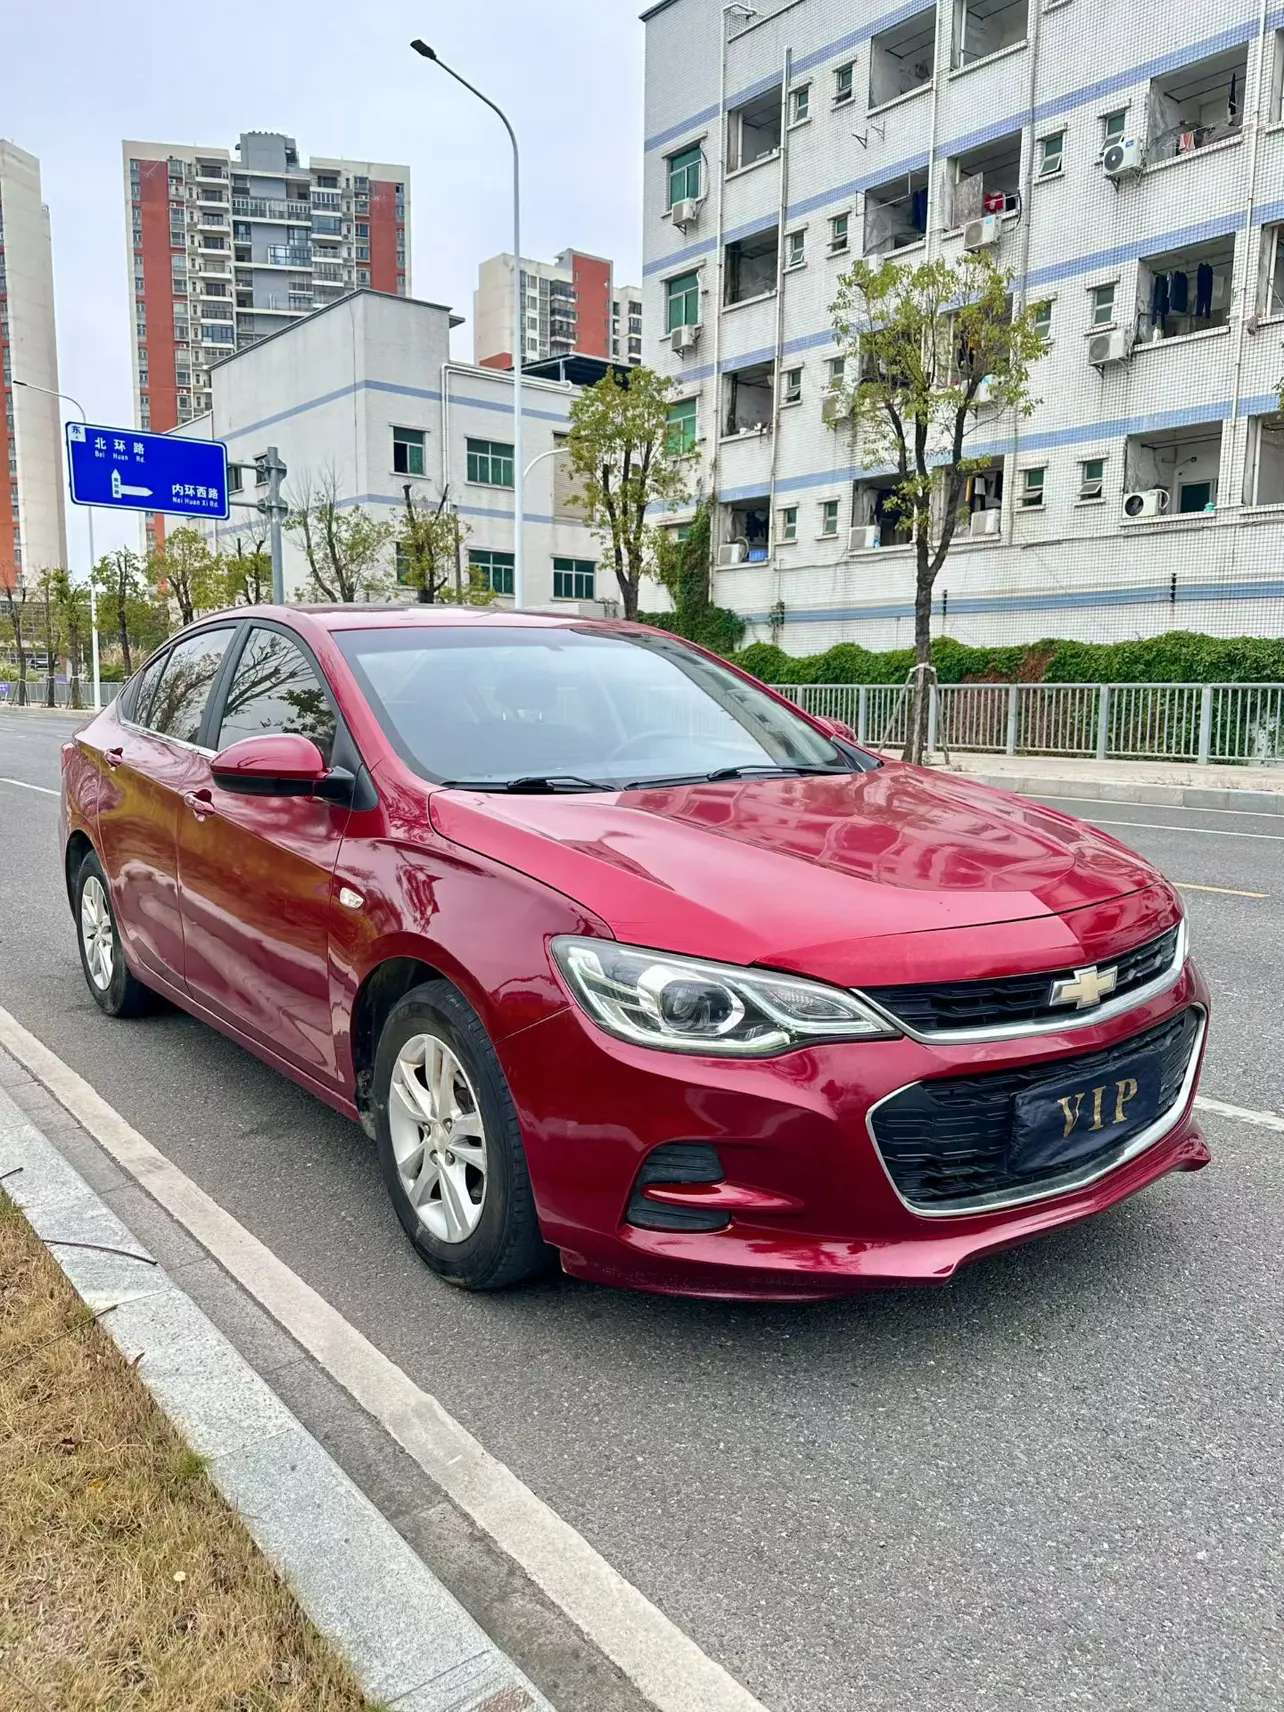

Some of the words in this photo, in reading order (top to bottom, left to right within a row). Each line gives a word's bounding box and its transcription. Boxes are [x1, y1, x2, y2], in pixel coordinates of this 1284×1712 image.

[94, 436, 145, 455] 北环路
[94, 450, 106, 458] Bei
[112, 452, 129, 461] Huan
[171, 483, 219, 500] 内环西路
[1056, 1077, 1138, 1139] VIP
